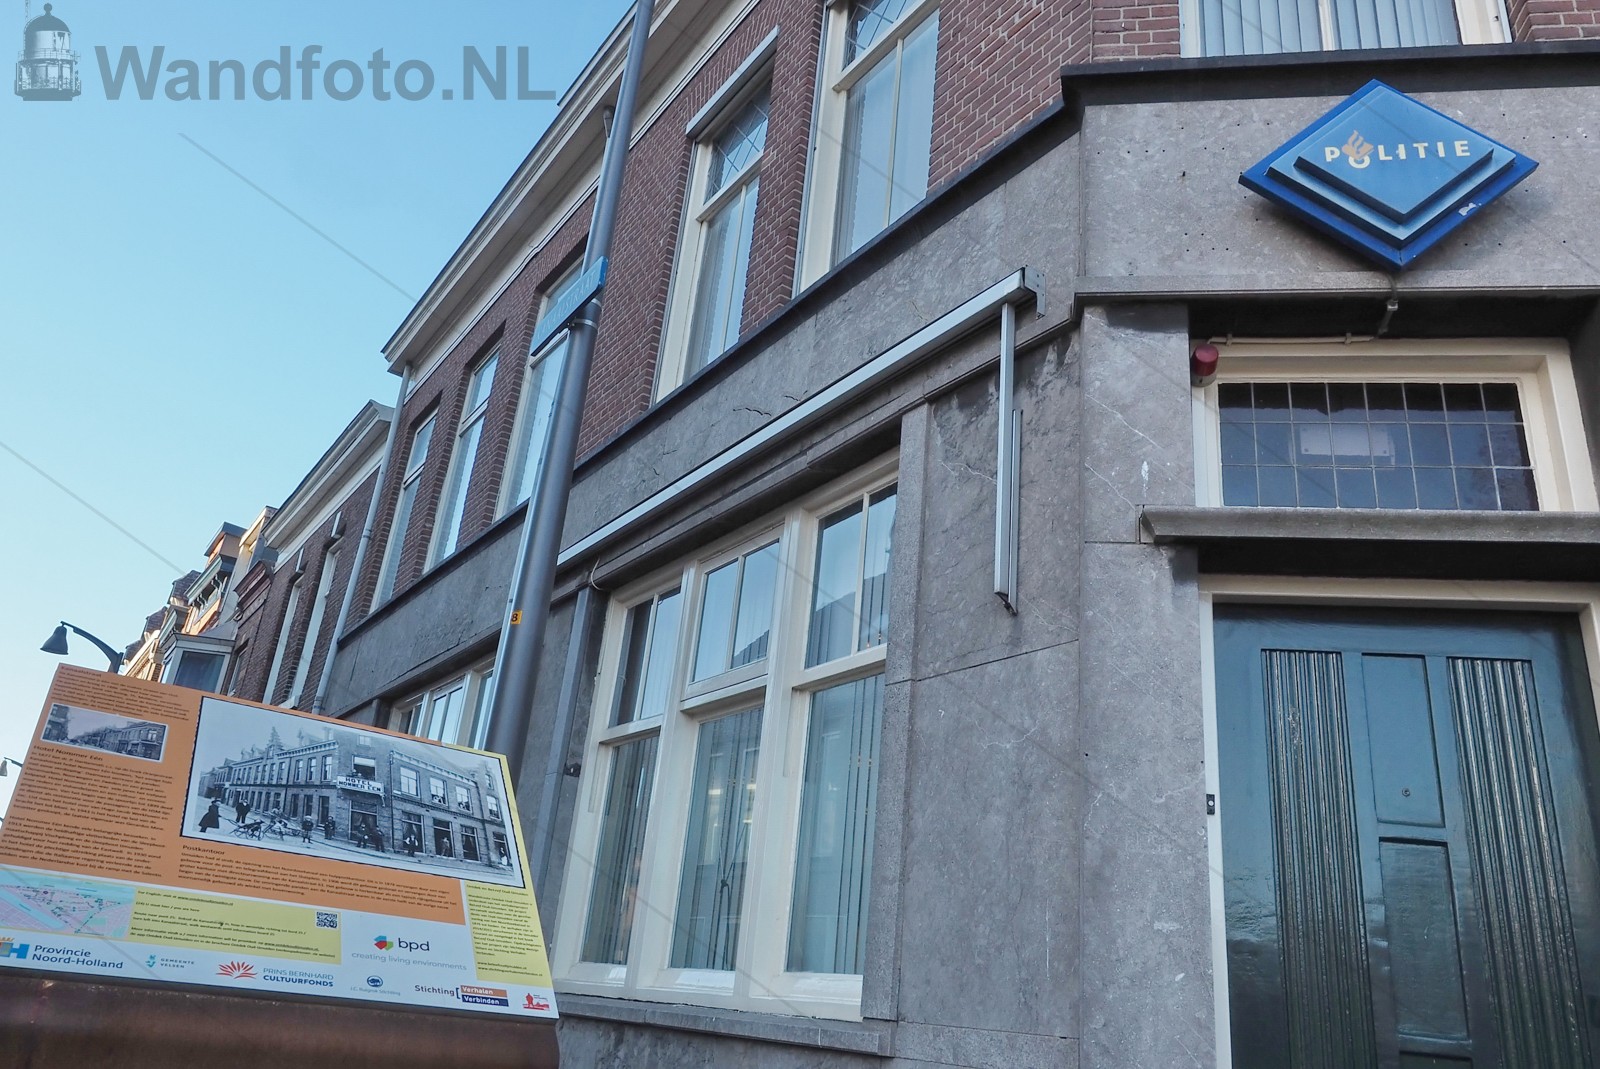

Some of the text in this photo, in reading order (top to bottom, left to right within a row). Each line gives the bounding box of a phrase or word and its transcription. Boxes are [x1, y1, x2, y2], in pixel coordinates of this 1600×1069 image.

[1324, 140, 1470, 168] POLITIE
[346, 778, 371, 786] HOTEL
[34, 944, 91, 958] Provincie
[398, 938, 430, 952] bpd
[32, 953, 124, 970] Noord-Holland
[351, 952, 387, 962] creating
[388, 955, 410, 966] living
[412, 959, 468, 971] environments
[263, 968, 334, 981] PRINS BERNHARD
[263, 974, 334, 987] CULTUURFONDS
[414, 984, 494, 997] Stichting Verhalen
[464, 996, 500, 1005] Verbinden
